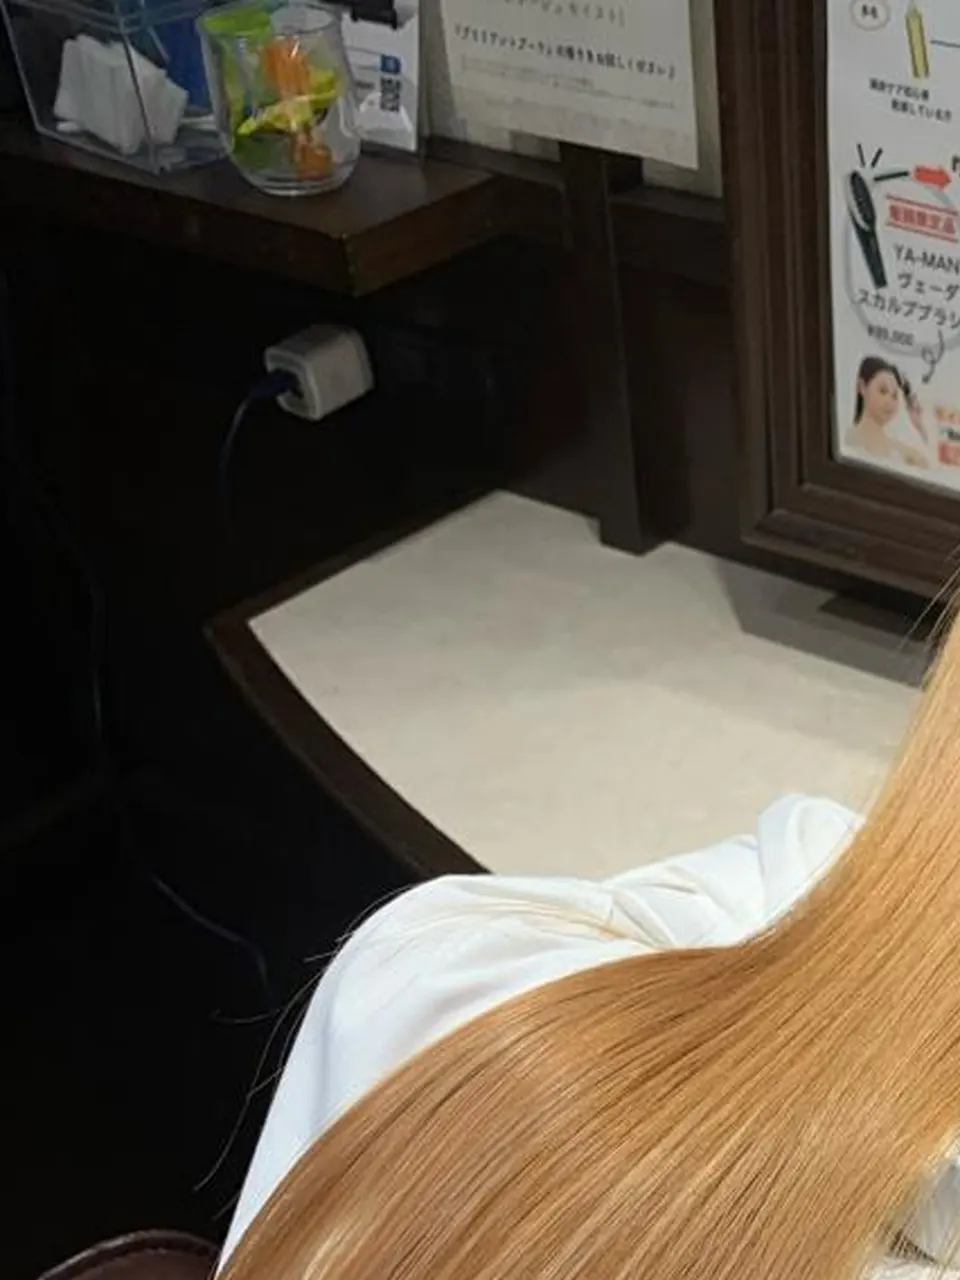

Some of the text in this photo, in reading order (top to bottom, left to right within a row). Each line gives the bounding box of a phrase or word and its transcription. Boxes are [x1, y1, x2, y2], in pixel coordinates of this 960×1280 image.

[894, 243, 960, 274] YA-MAN
[898, 273, 960, 301] ヴェーダ
